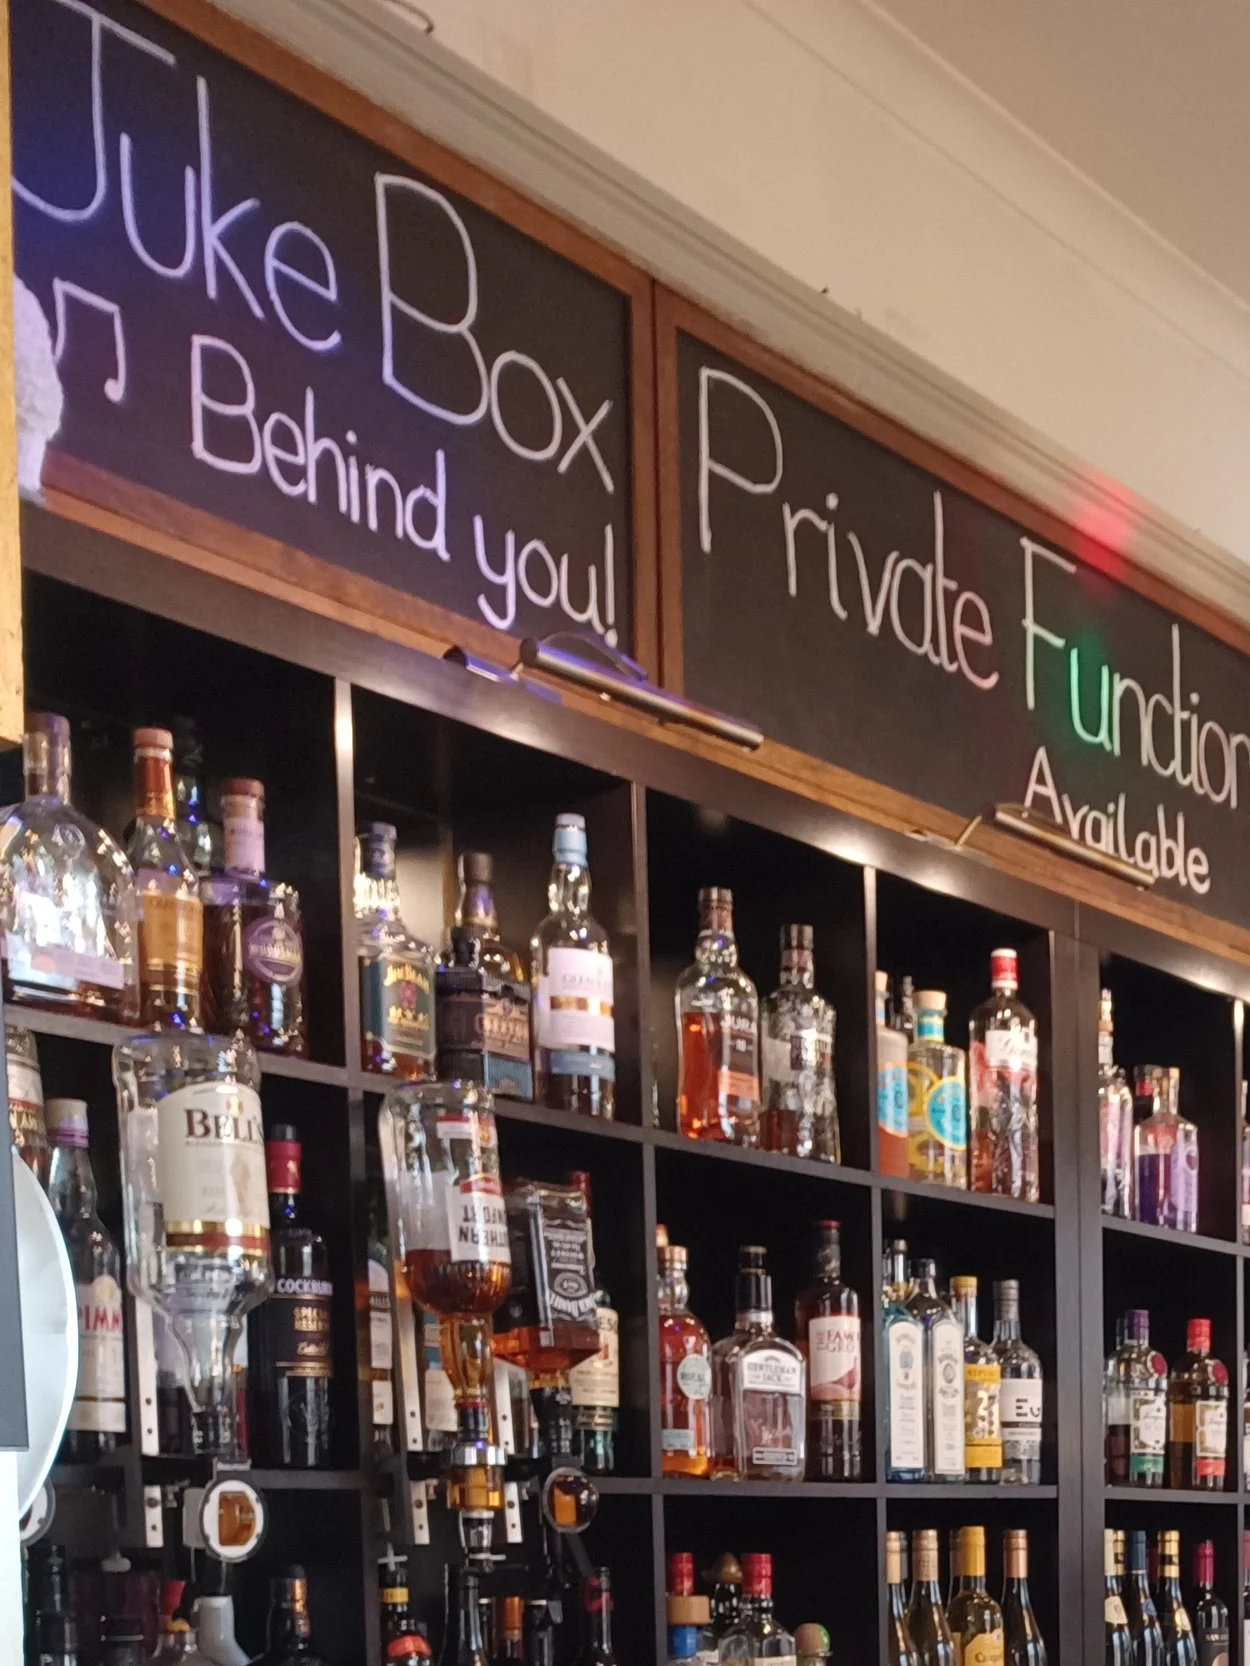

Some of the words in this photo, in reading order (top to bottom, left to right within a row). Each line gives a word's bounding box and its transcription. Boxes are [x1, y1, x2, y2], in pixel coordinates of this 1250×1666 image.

[12, 0, 341, 350] Juke
[375, 172, 615, 493] Box
[190, 334, 450, 562] Behind
[473, 513, 619, 645] you!
[698, 365, 999, 690] Private
[1023, 746, 1212, 893] Available
[747, 1363, 798, 1375] GENTLEMAN
